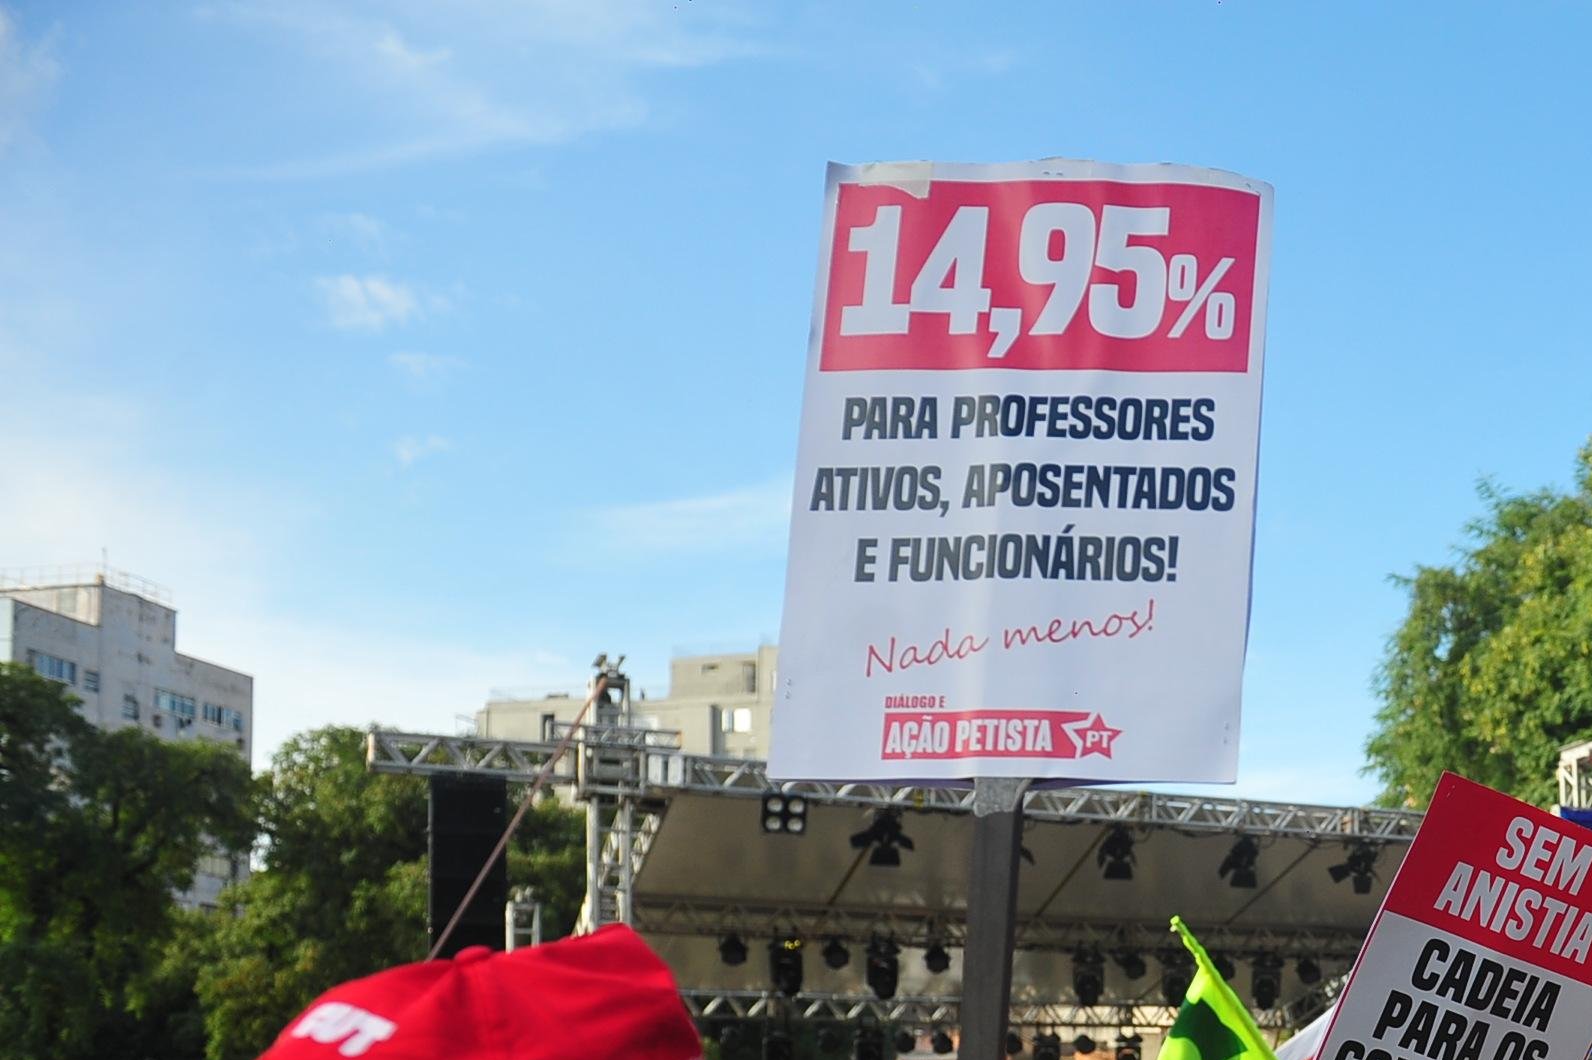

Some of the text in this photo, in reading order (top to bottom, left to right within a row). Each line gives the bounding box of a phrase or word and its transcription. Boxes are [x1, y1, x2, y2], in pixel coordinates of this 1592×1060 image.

[839, 202, 1236, 358] 14,95%
[842, 394, 1215, 441] PARA PROFESSORES
[810, 463, 1236, 517] ATIVOS, APOSENTADOS
[854, 524, 1179, 582] E FUNCIONÁRIOS!
[865, 599, 1155, 678] Nada menos!
[884, 695, 946, 709] DIÁLOGO E
[885, 715, 1112, 758] AÇÃO PETISTA PT
[1411, 938, 1561, 1032] CADEIA
